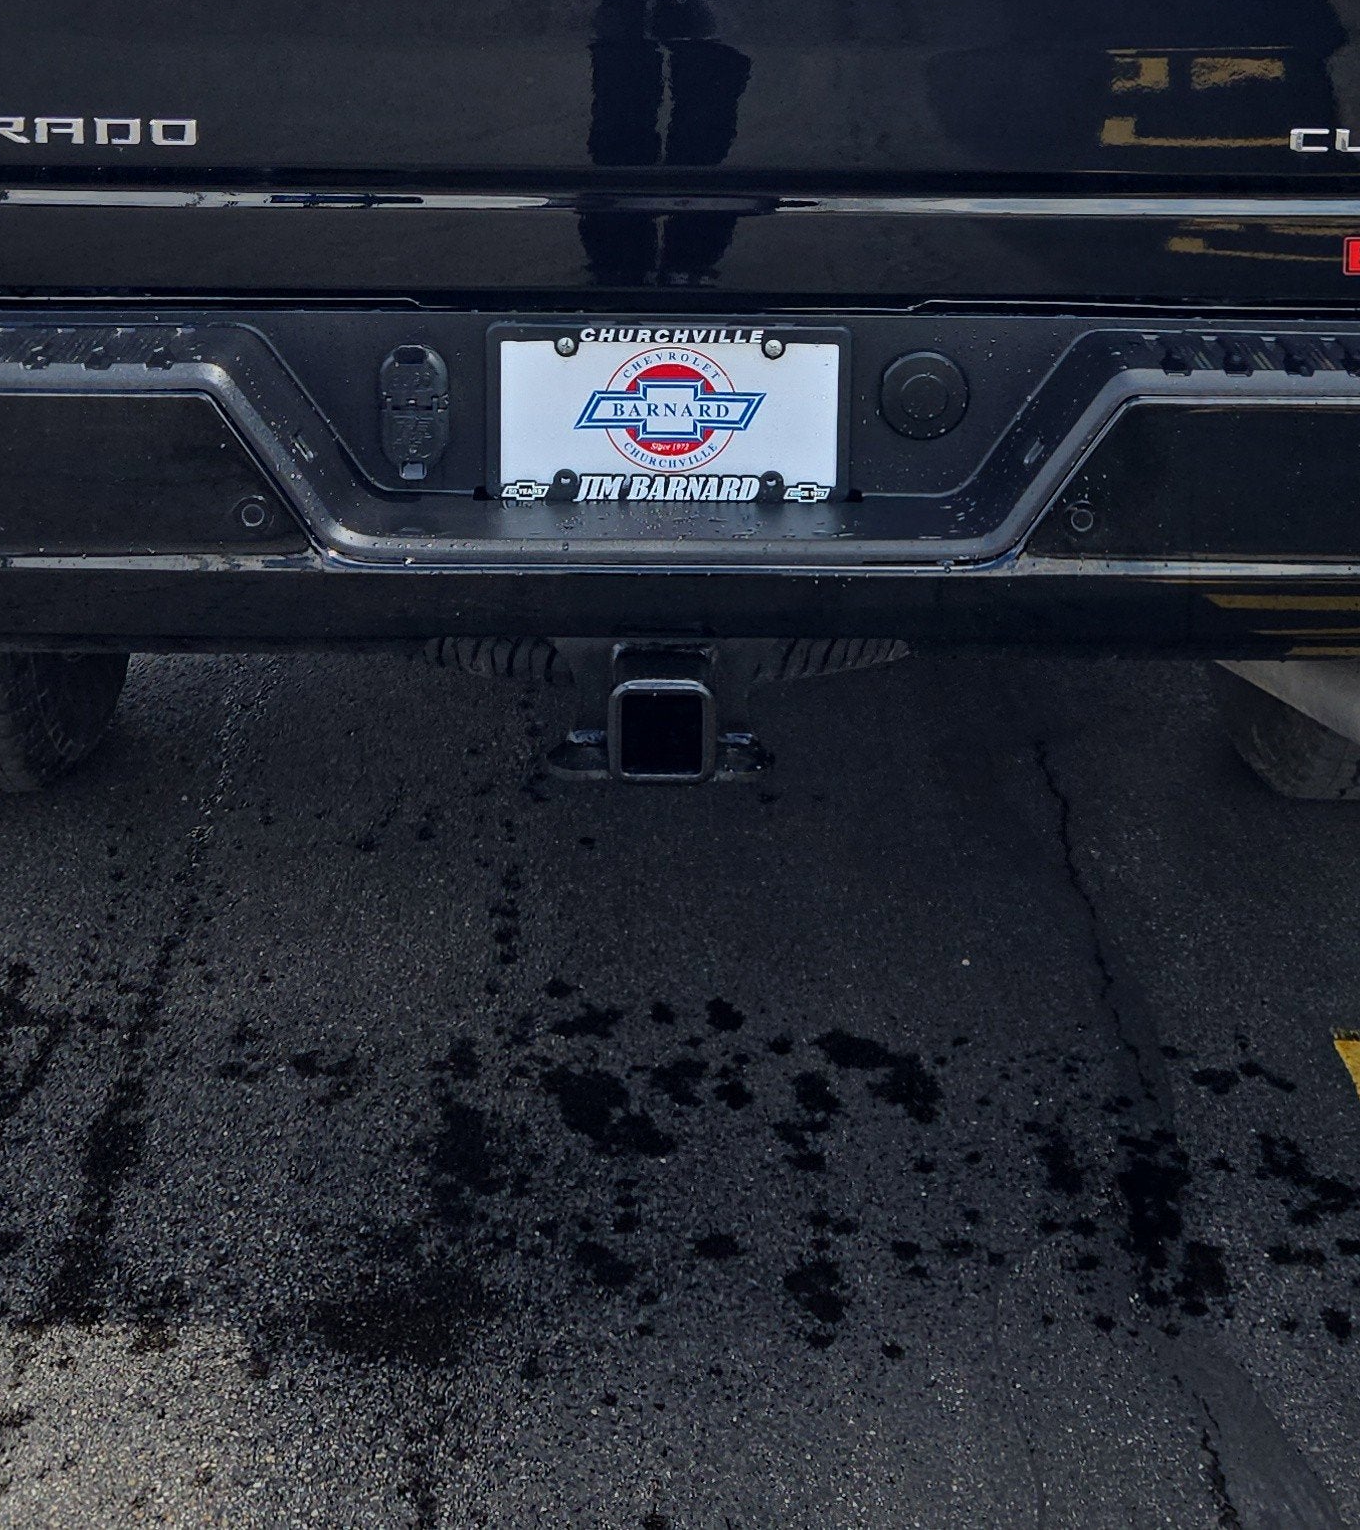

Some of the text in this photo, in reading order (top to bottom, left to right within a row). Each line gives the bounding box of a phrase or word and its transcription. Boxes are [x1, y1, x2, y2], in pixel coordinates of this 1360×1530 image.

[580, 328, 764, 343] CHURCHVILLE
[623, 351, 721, 380] CHEVROLET
[612, 403, 730, 418] BARNARD
[624, 442, 718, 468] CHURCHVILLE
[573, 475, 761, 502] JIM BARNARD
